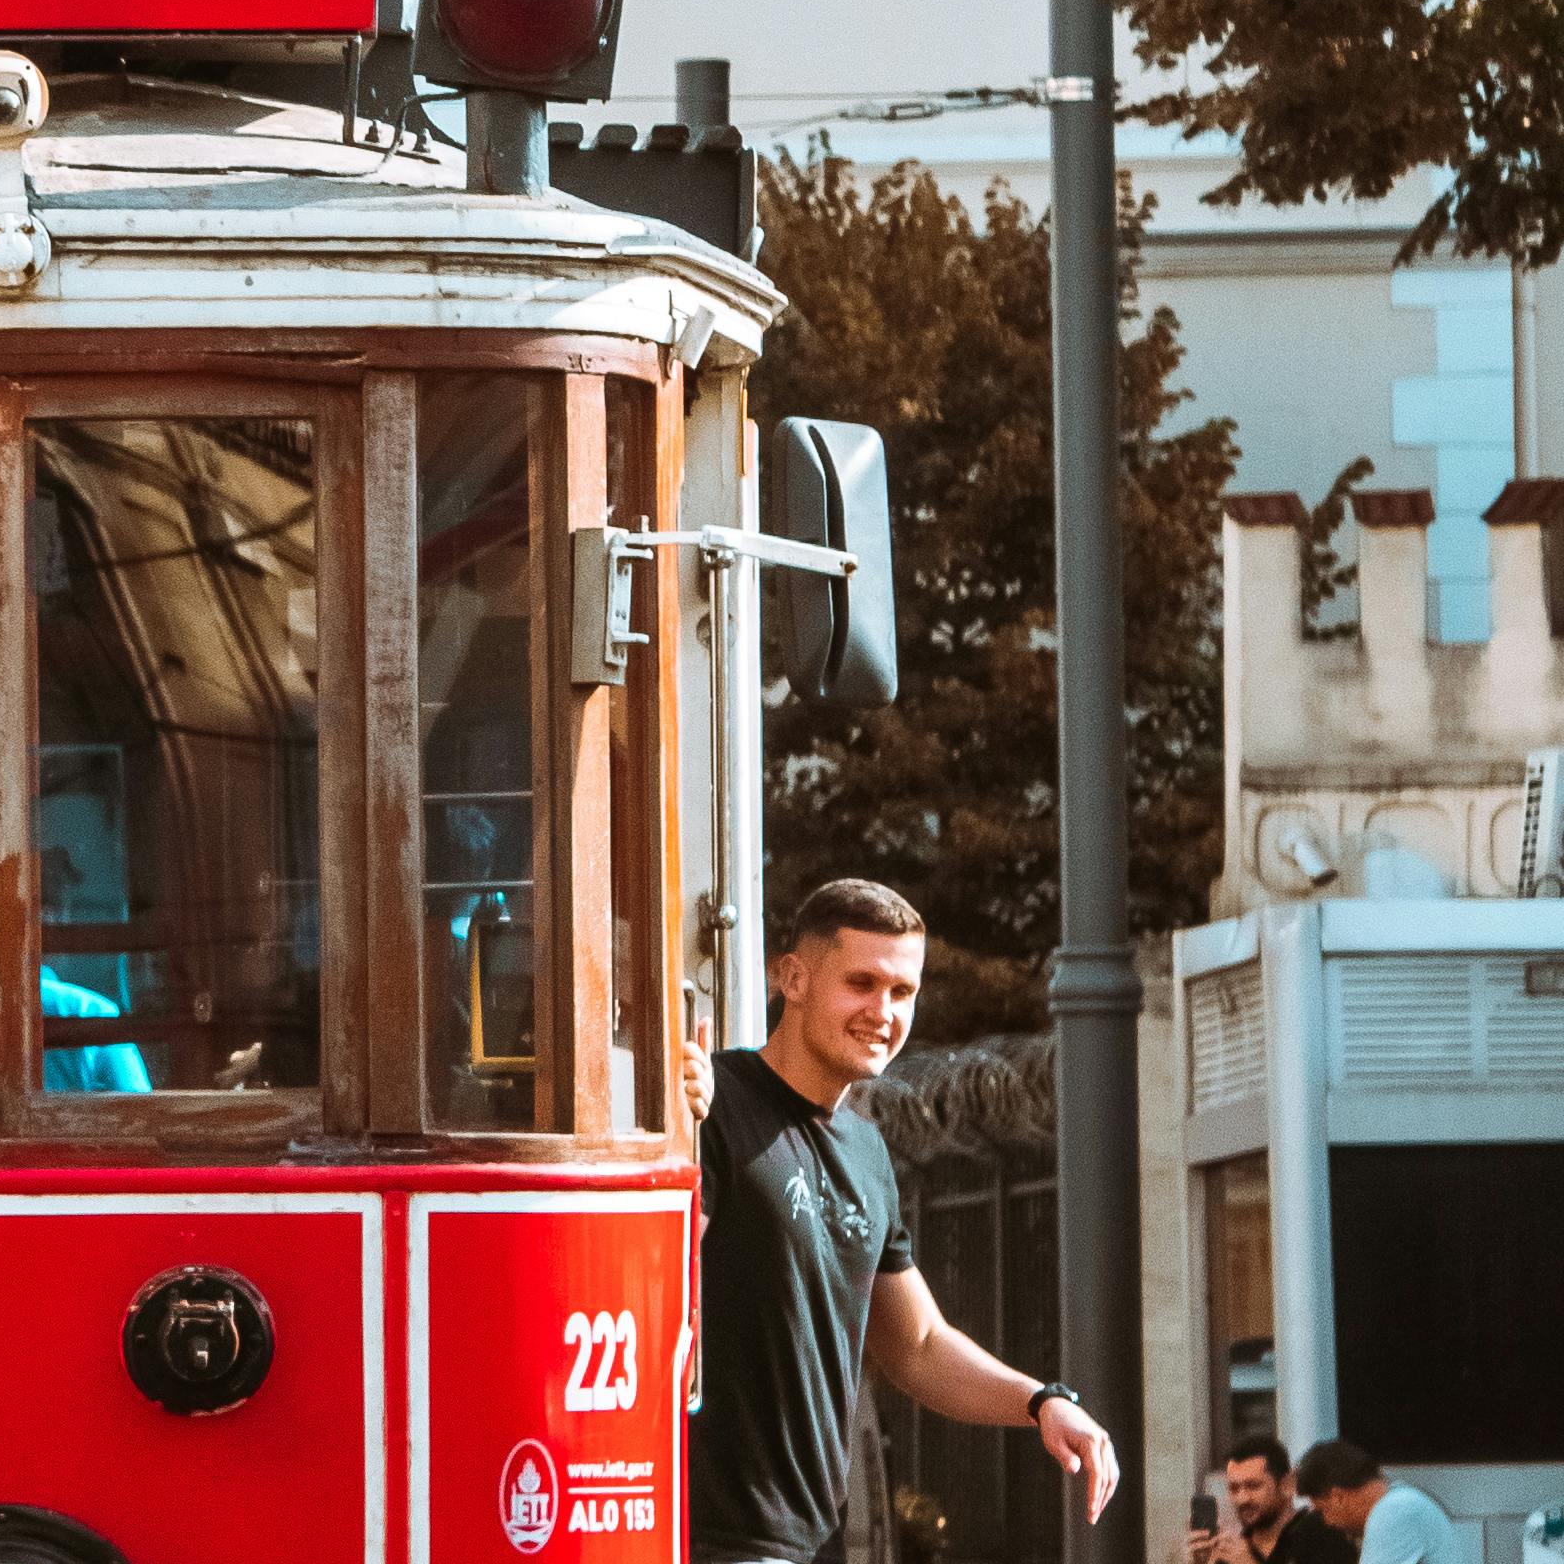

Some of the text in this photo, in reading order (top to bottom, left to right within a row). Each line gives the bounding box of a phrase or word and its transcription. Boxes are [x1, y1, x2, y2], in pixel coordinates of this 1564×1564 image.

[564, 1310, 637, 1412] 223
[568, 1498, 655, 1533] ALO 153
